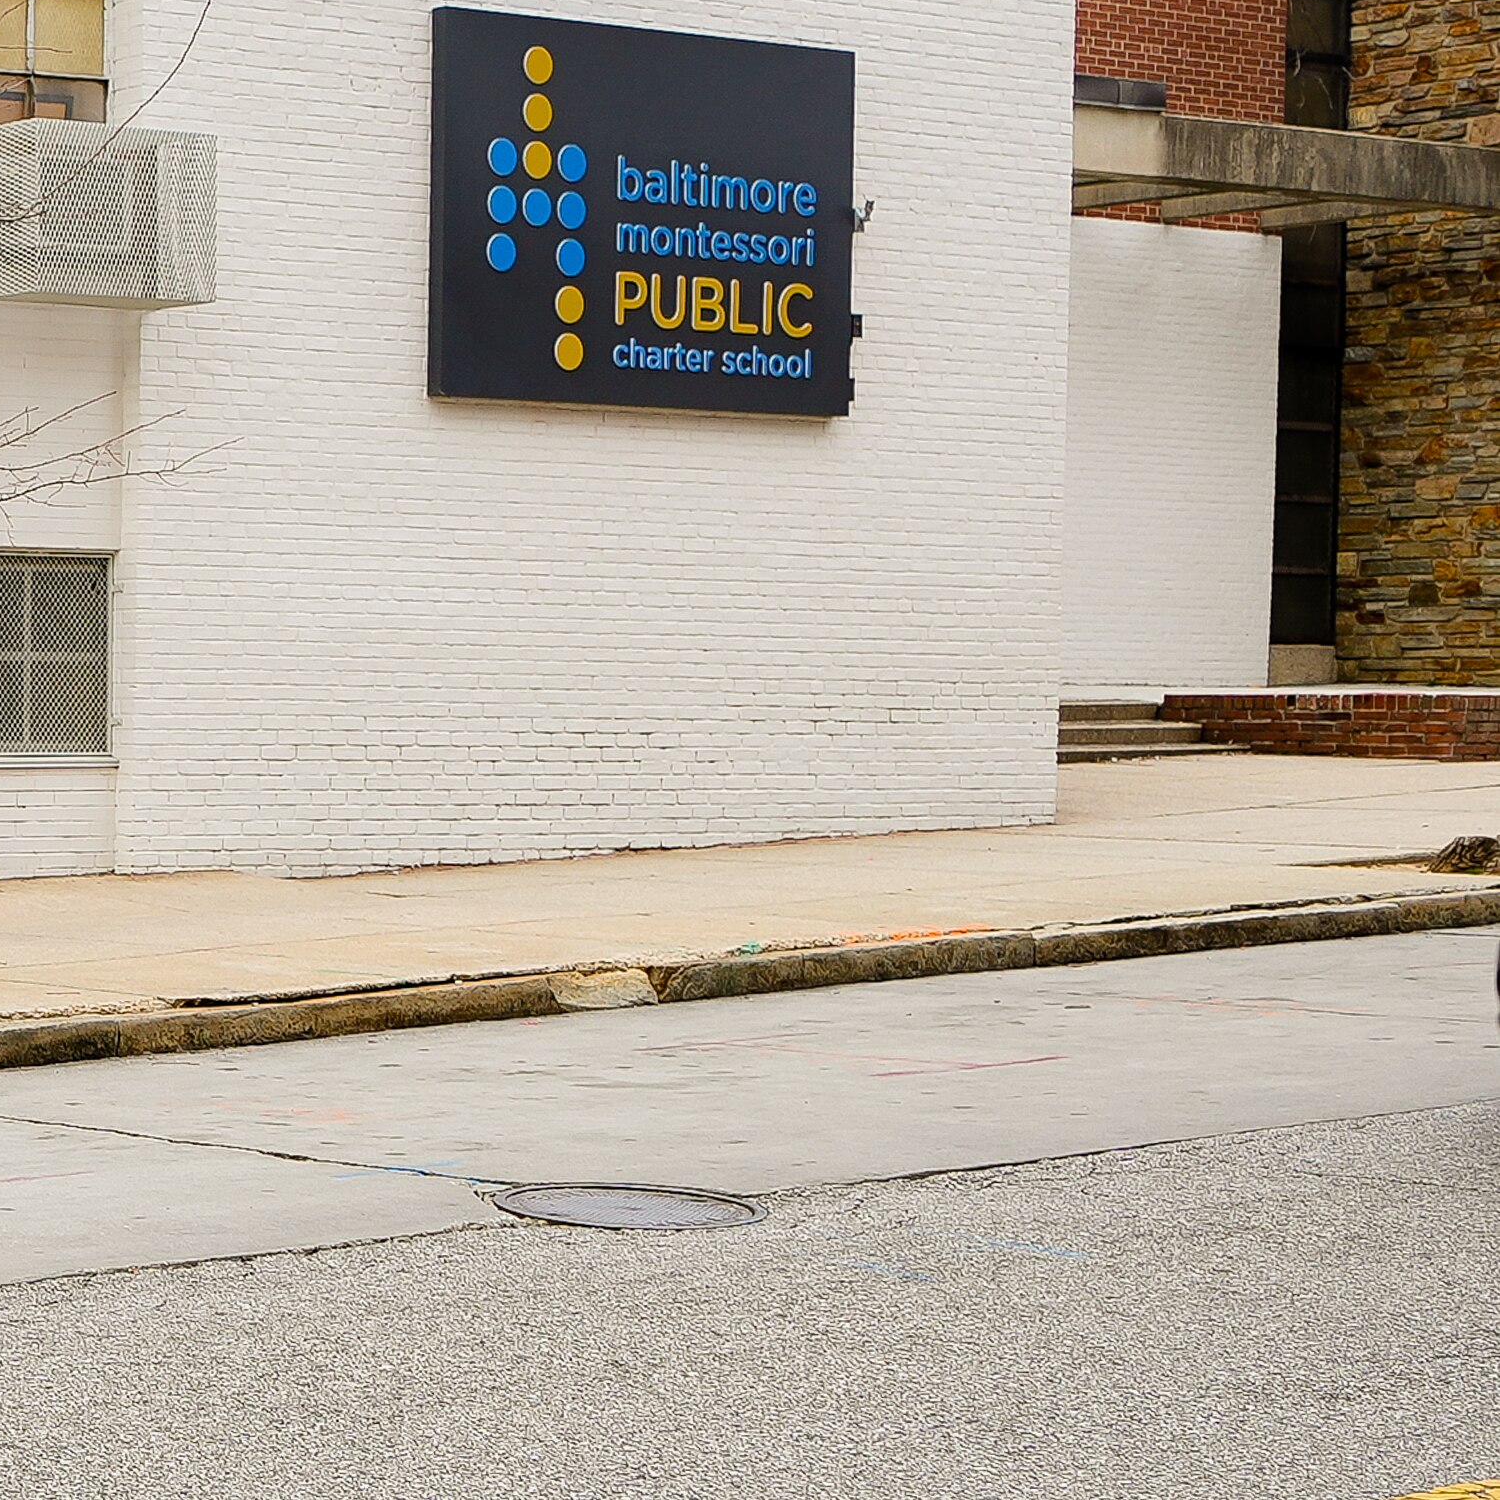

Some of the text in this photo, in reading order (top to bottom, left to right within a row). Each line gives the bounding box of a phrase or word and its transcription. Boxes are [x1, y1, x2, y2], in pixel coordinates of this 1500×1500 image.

[616, 154, 818, 217] baltimore
[616, 222, 816, 267] montessori
[614, 271, 814, 338] PUBLIC
[612, 337, 812, 379] charter school
